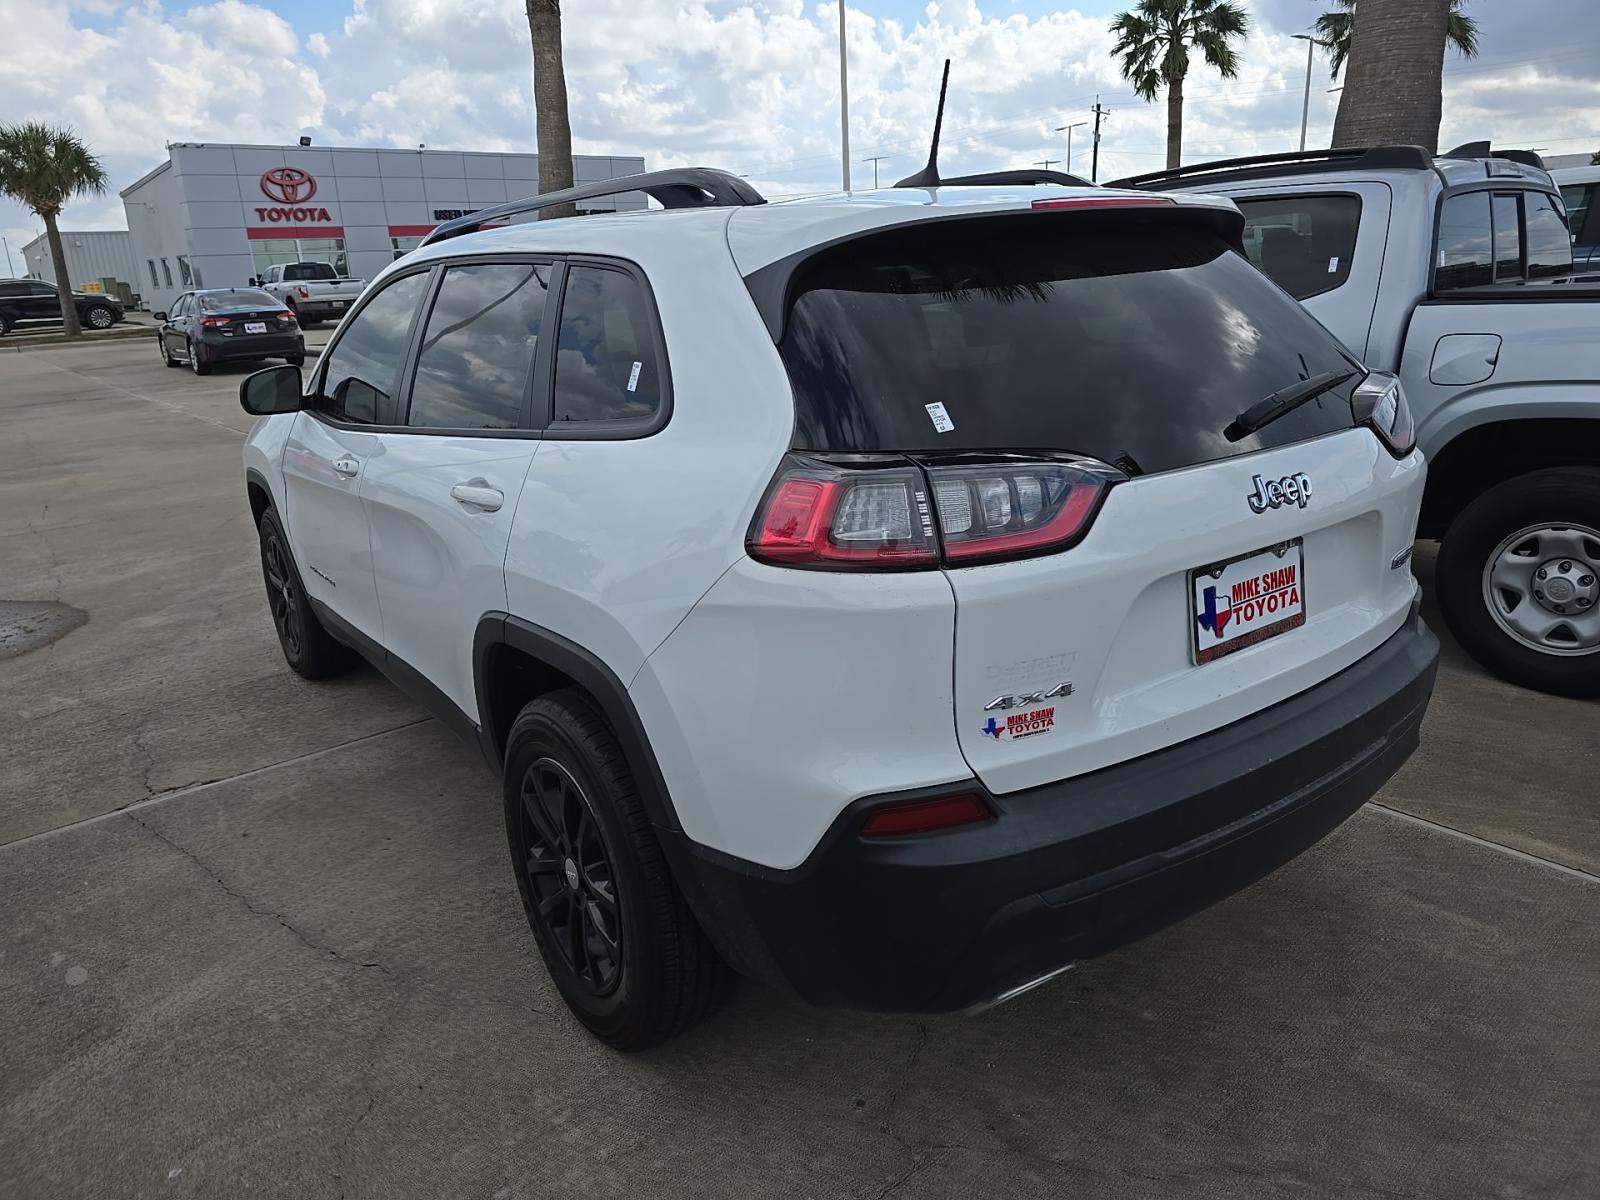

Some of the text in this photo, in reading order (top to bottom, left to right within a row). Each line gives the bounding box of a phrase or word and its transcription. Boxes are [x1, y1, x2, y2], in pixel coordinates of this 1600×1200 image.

[254, 207, 332, 222] TOYOTA
[1247, 472, 1312, 514] Jeep
[1232, 565, 1295, 603] MIKE SHAW
[1233, 587, 1299, 625] TOYOTA
[1007, 707, 1054, 726] MIKE SHAW
[1007, 718, 1054, 734] TOYOTA
